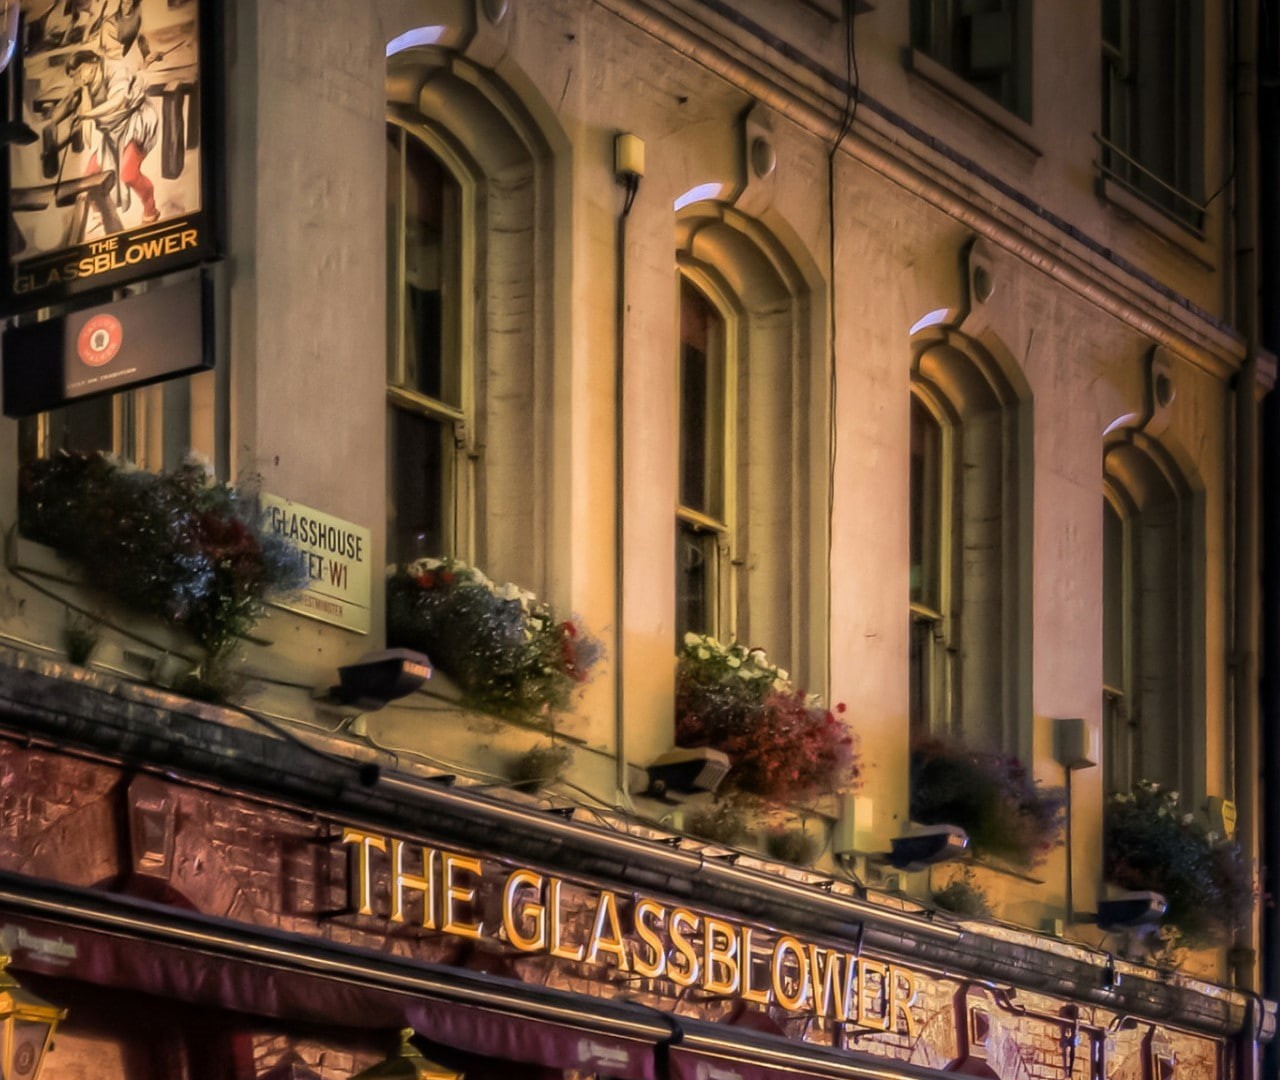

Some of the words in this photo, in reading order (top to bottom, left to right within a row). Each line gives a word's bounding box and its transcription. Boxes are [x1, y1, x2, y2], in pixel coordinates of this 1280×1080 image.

[13, 229, 198, 294] GLASSBLOWER
[89, 237, 119, 255] THE
[272, 506, 363, 563] GLASSHOUSE
[328, 559, 348, 591] W1
[301, 594, 343, 617] ESTMINSTER
[342, 826, 484, 940] THE
[501, 867, 920, 1040] GLASSBLOWER
